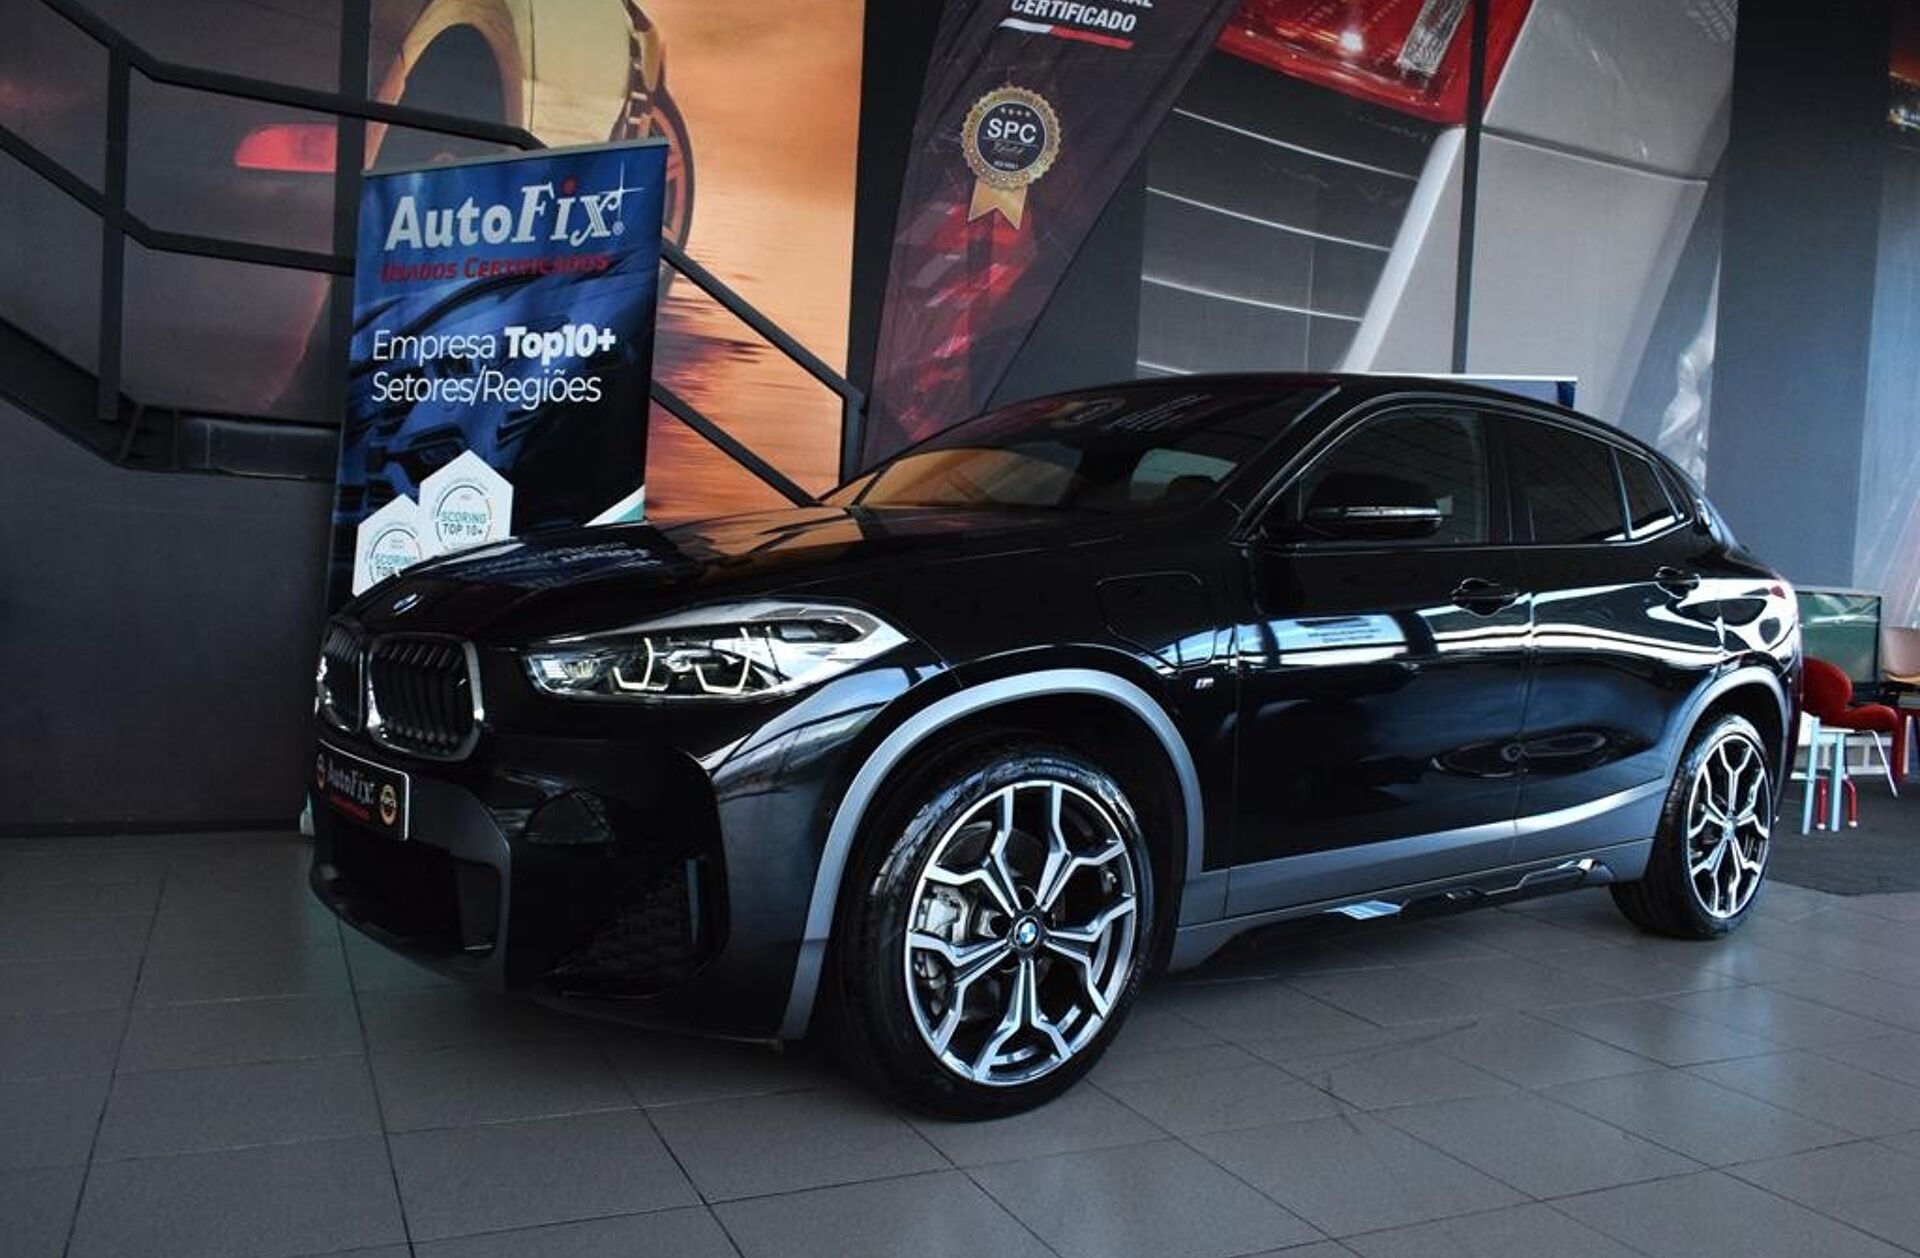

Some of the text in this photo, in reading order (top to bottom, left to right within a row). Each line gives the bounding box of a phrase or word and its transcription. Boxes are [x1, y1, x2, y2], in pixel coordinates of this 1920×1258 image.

[1010, 0, 1137, 33] CERTIFICADO
[987, 118, 1037, 144] SPC
[372, 324, 616, 365] Empresa Top10+
[371, 364, 602, 410] Setores/Regiões
[440, 511, 487, 525] SCORING
[442, 523, 464, 536] TOP
